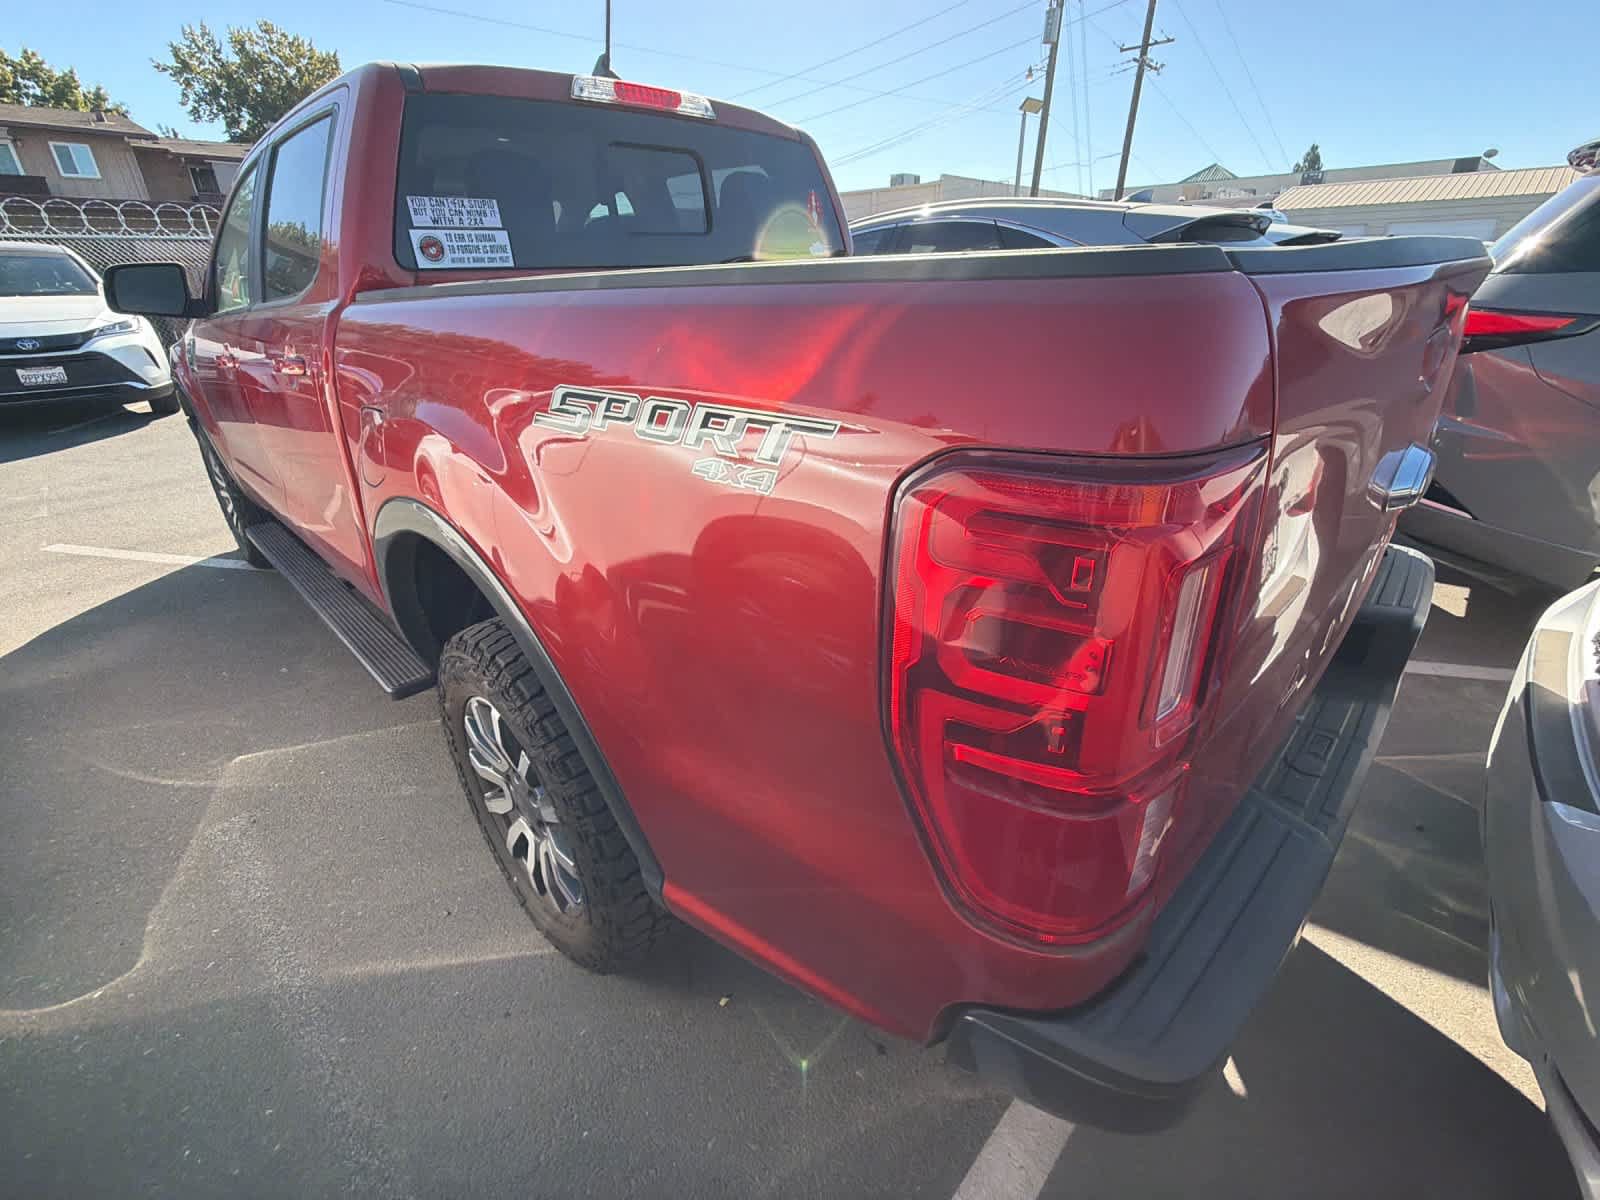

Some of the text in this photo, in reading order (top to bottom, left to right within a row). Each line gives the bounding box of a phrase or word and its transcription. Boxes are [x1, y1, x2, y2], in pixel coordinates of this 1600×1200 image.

[410, 197, 426, 208] YOU
[453, 199, 466, 209] FIX
[469, 199, 495, 209] STUPID
[413, 207, 497, 218] BUT YOU CAN NUMB IT
[430, 216, 455, 225] WITH
[459, 217, 465, 225] A
[444, 232, 496, 243] TO ERR IS HUMAN
[448, 244, 509, 254] TO FORGIVE IS DIVINE
[533, 384, 842, 465] SPORT
